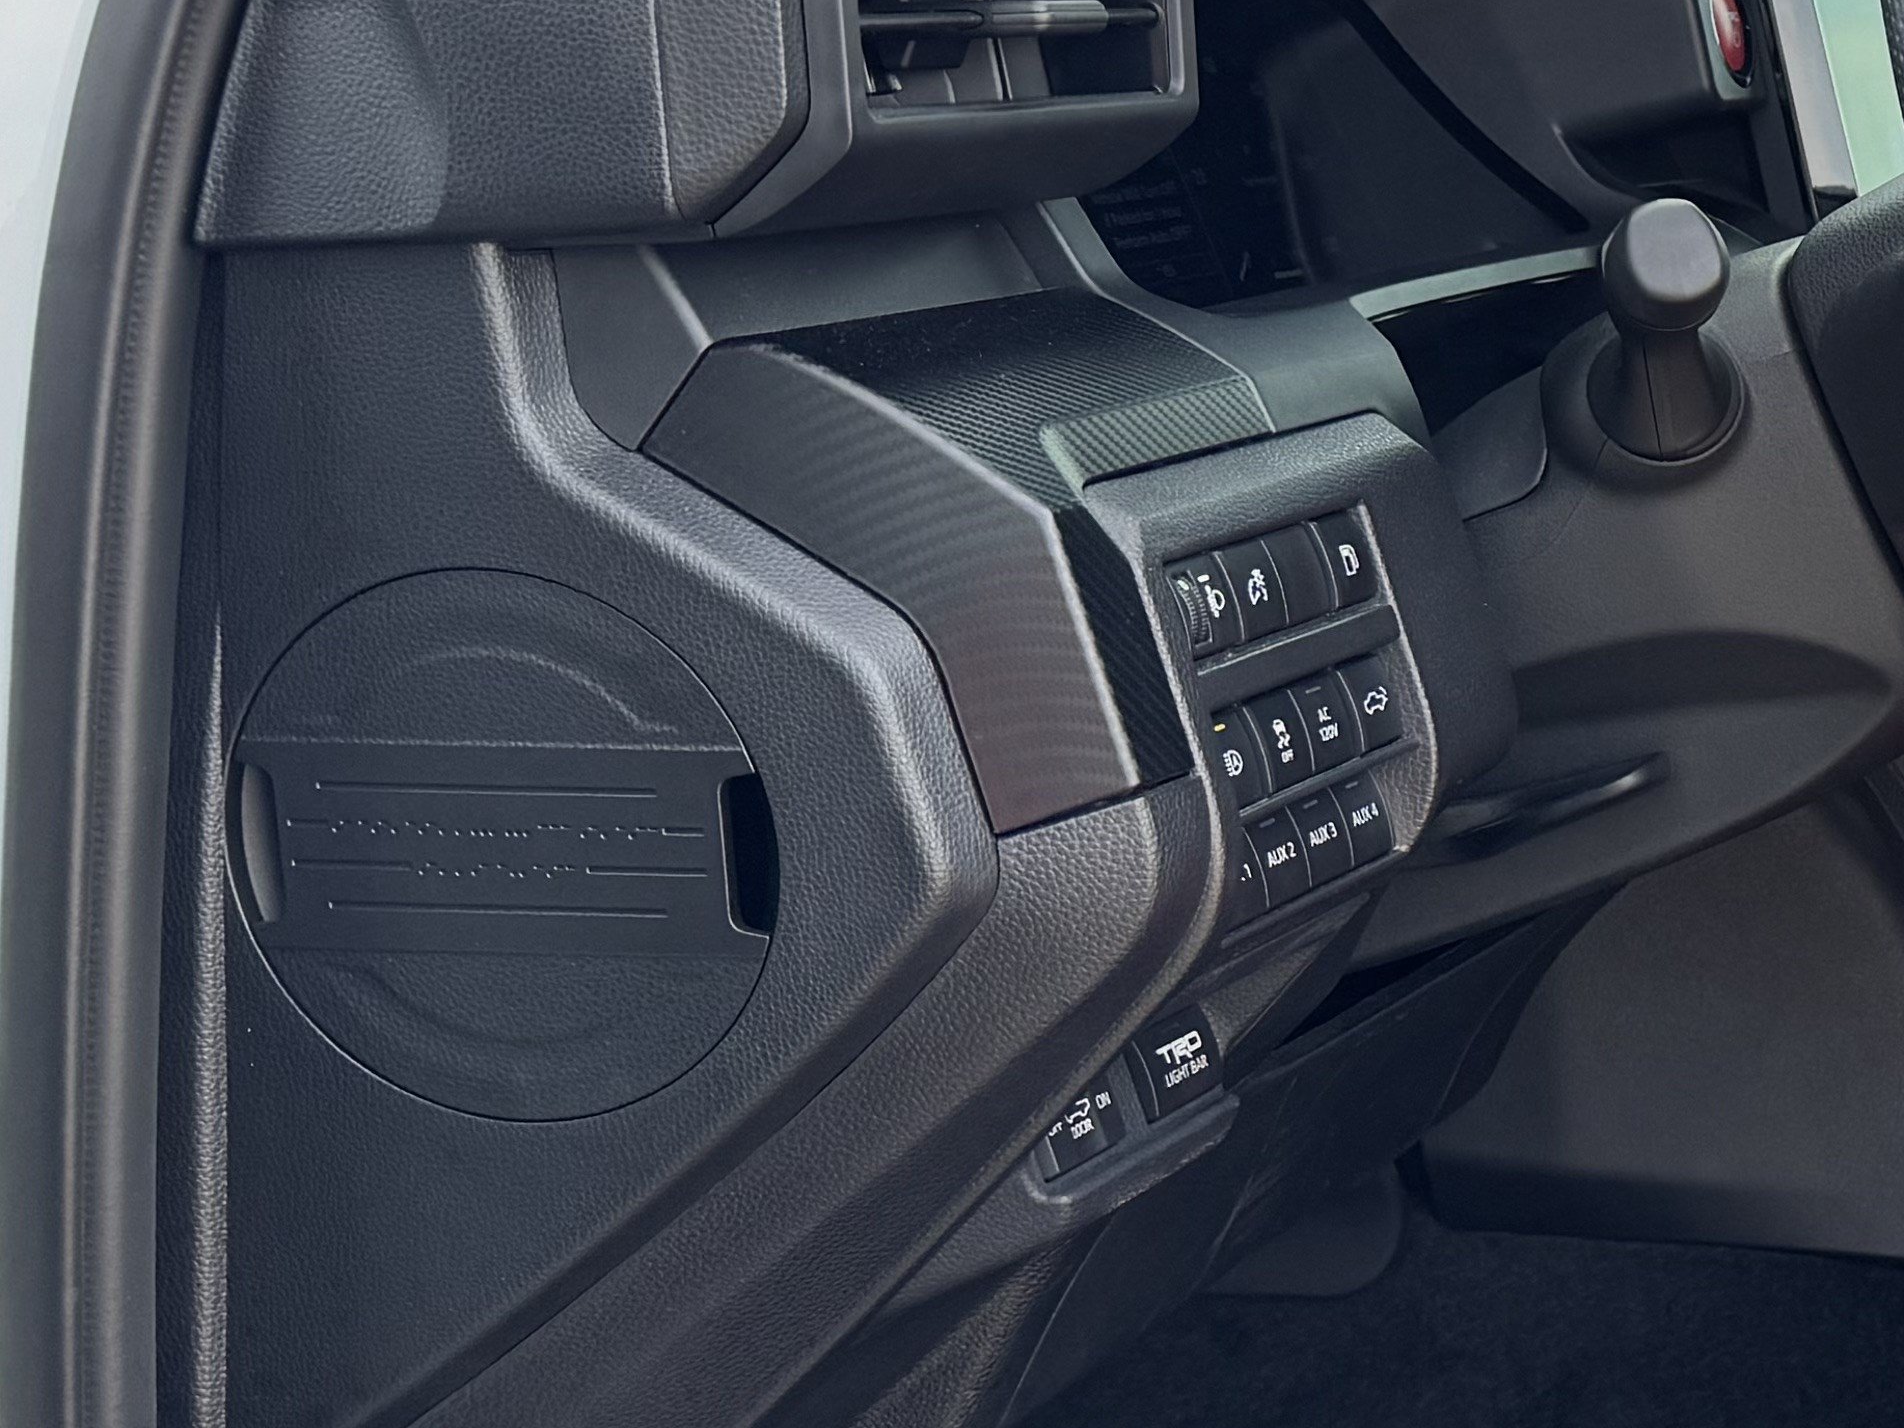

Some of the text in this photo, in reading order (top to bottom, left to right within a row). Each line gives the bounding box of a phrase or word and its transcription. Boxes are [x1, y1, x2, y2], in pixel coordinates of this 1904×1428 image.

[1317, 706, 1331, 723] AC
[1352, 803, 1379, 827] AUX 4
[1309, 822, 1338, 847] AUX 3
[1267, 842, 1297, 868] AUX 2
[1155, 1029, 1203, 1065] TRD
[1164, 1054, 1209, 1088] LIGHT BAR
[1095, 1091, 1112, 1110] ON
[1070, 1117, 1095, 1140] DOOR
